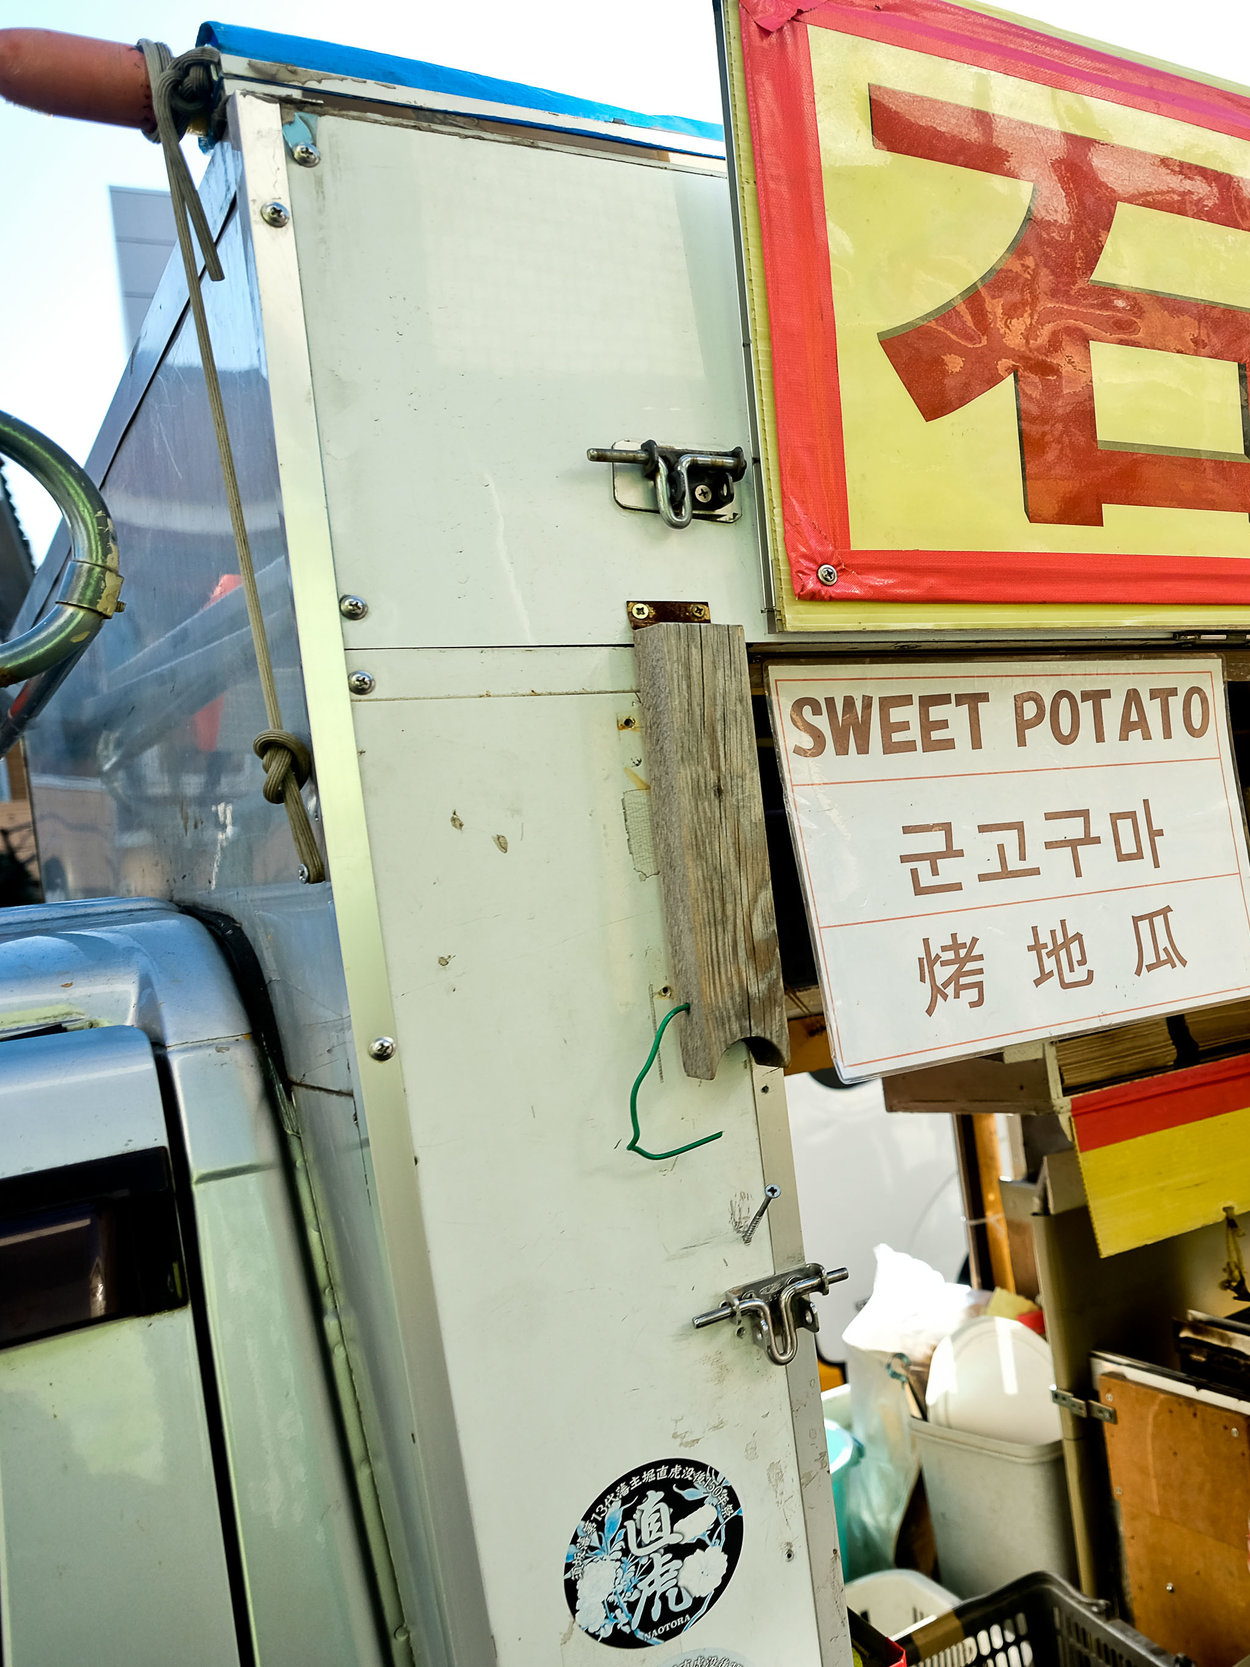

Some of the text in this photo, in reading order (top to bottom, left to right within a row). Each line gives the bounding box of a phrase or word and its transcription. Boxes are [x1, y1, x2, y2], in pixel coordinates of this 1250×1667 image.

[790, 686, 1210, 758] SWEET POTATO
[900, 799, 1164, 896] 군고구마
[918, 905, 1188, 1018] 烤地瓜
[624, 1490, 693, 1629] 直虎
[643, 1614, 691, 1640] NAOTORA
